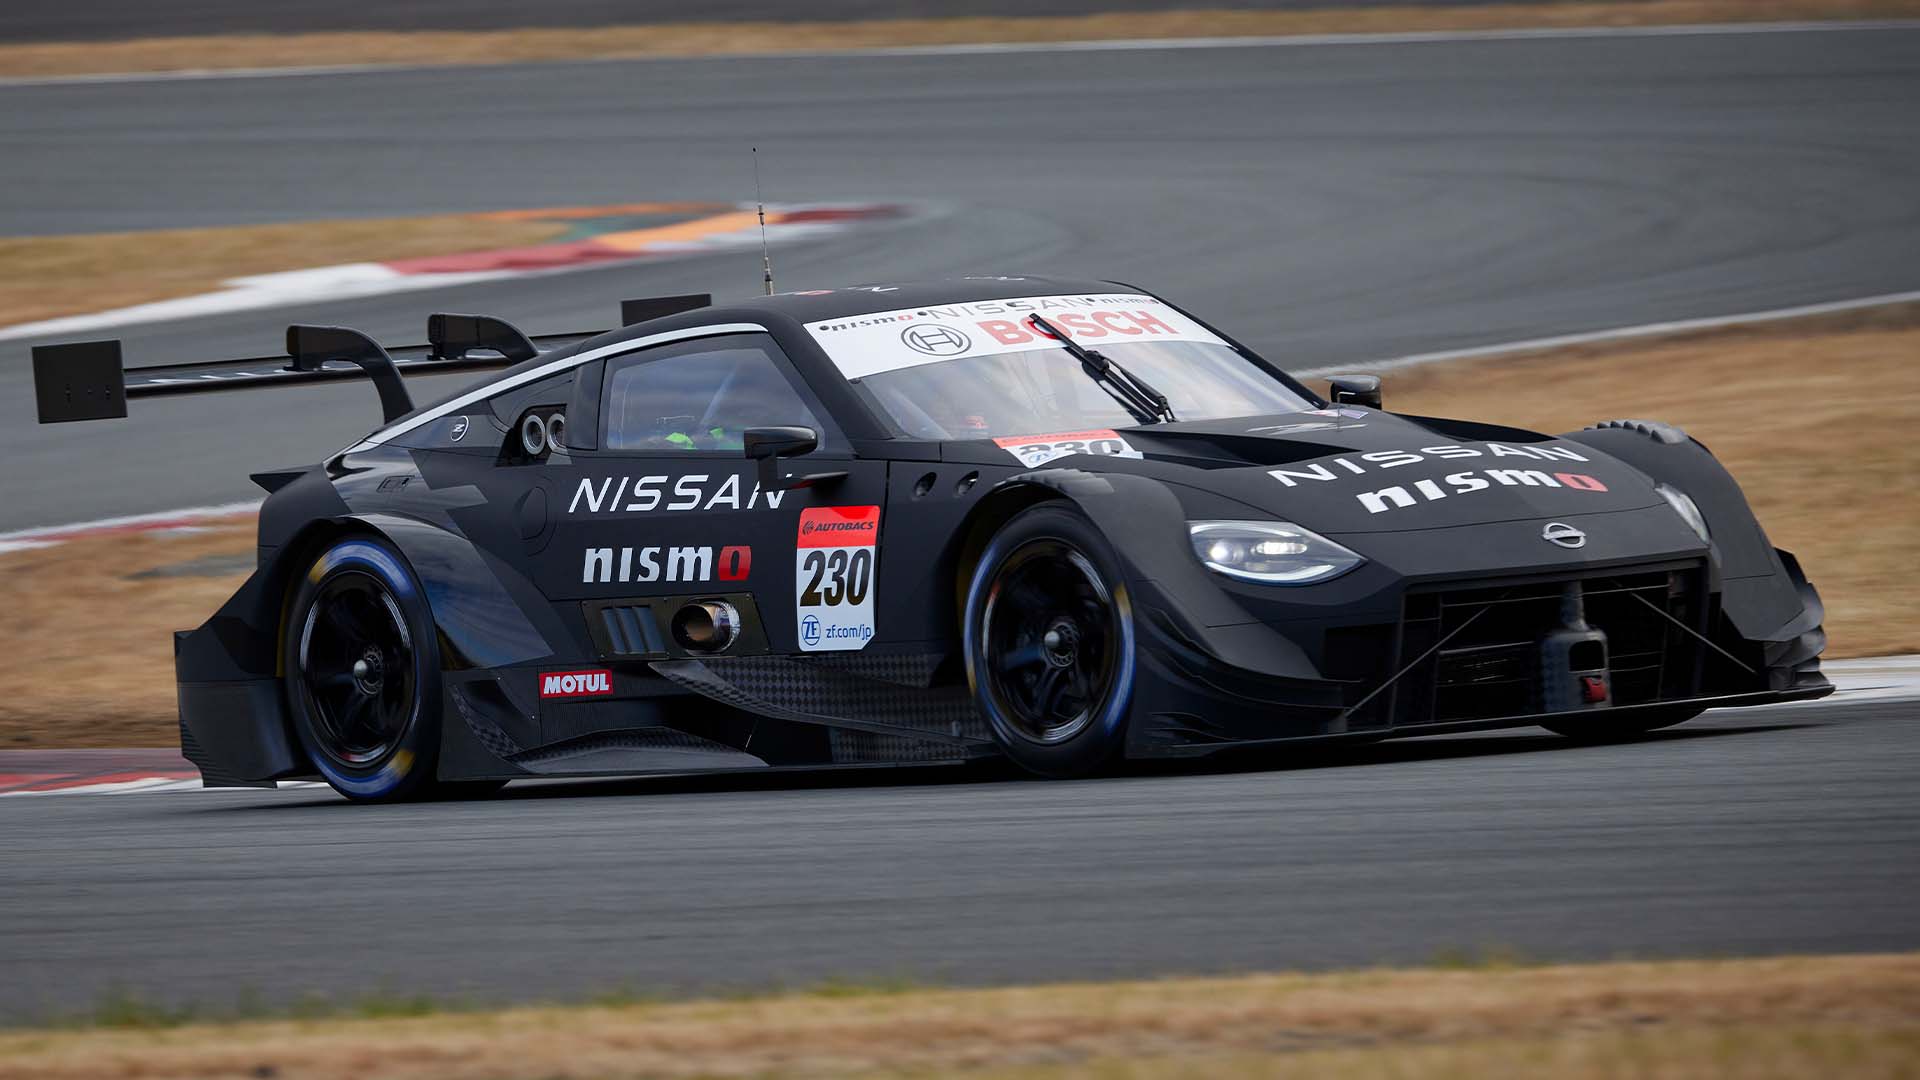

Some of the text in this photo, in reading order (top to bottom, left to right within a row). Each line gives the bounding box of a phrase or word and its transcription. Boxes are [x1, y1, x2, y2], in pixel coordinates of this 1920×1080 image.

[832, 314, 913, 331] nismo
[929, 297, 1096, 319] NISSAN
[976, 310, 1180, 346] BOSCH
[1267, 443, 1590, 487] NISSAN
[1356, 469, 1608, 514] nismo
[815, 521, 874, 532] AUTOBACS
[582, 545, 752, 583] nismo
[799, 548, 872, 607] 230
[803, 620, 872, 640] ZF zf.com/jp
[543, 673, 609, 694] MOTUL
